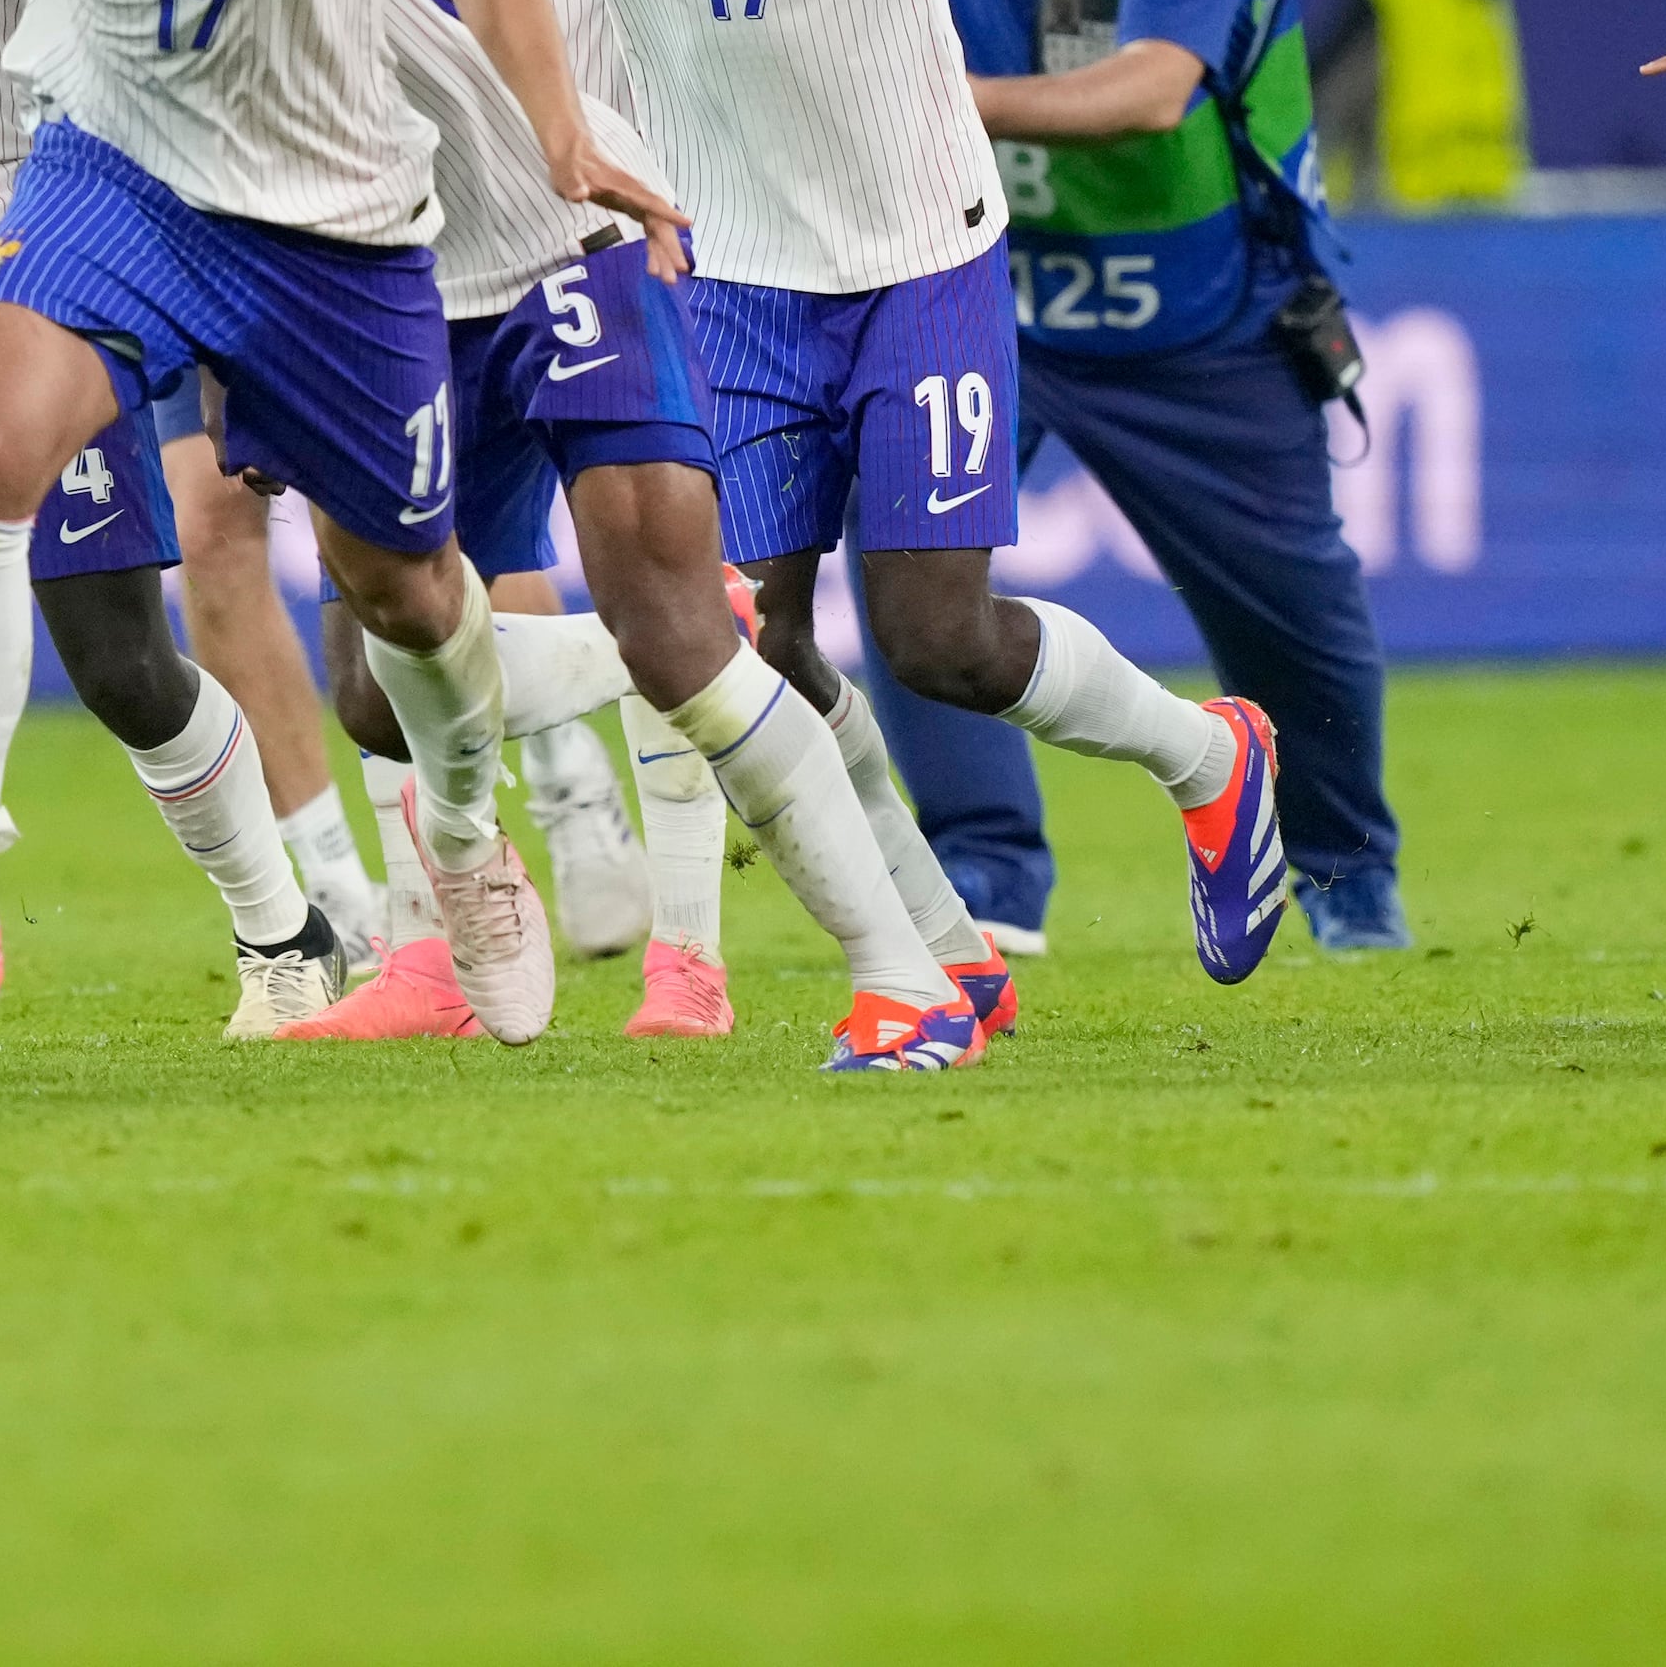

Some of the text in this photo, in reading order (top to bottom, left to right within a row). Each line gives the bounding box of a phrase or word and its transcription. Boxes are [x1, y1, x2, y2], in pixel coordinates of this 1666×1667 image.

[540, 264, 602, 348] 5
[914, 372, 994, 479] 19
[61, 445, 115, 504] 4
